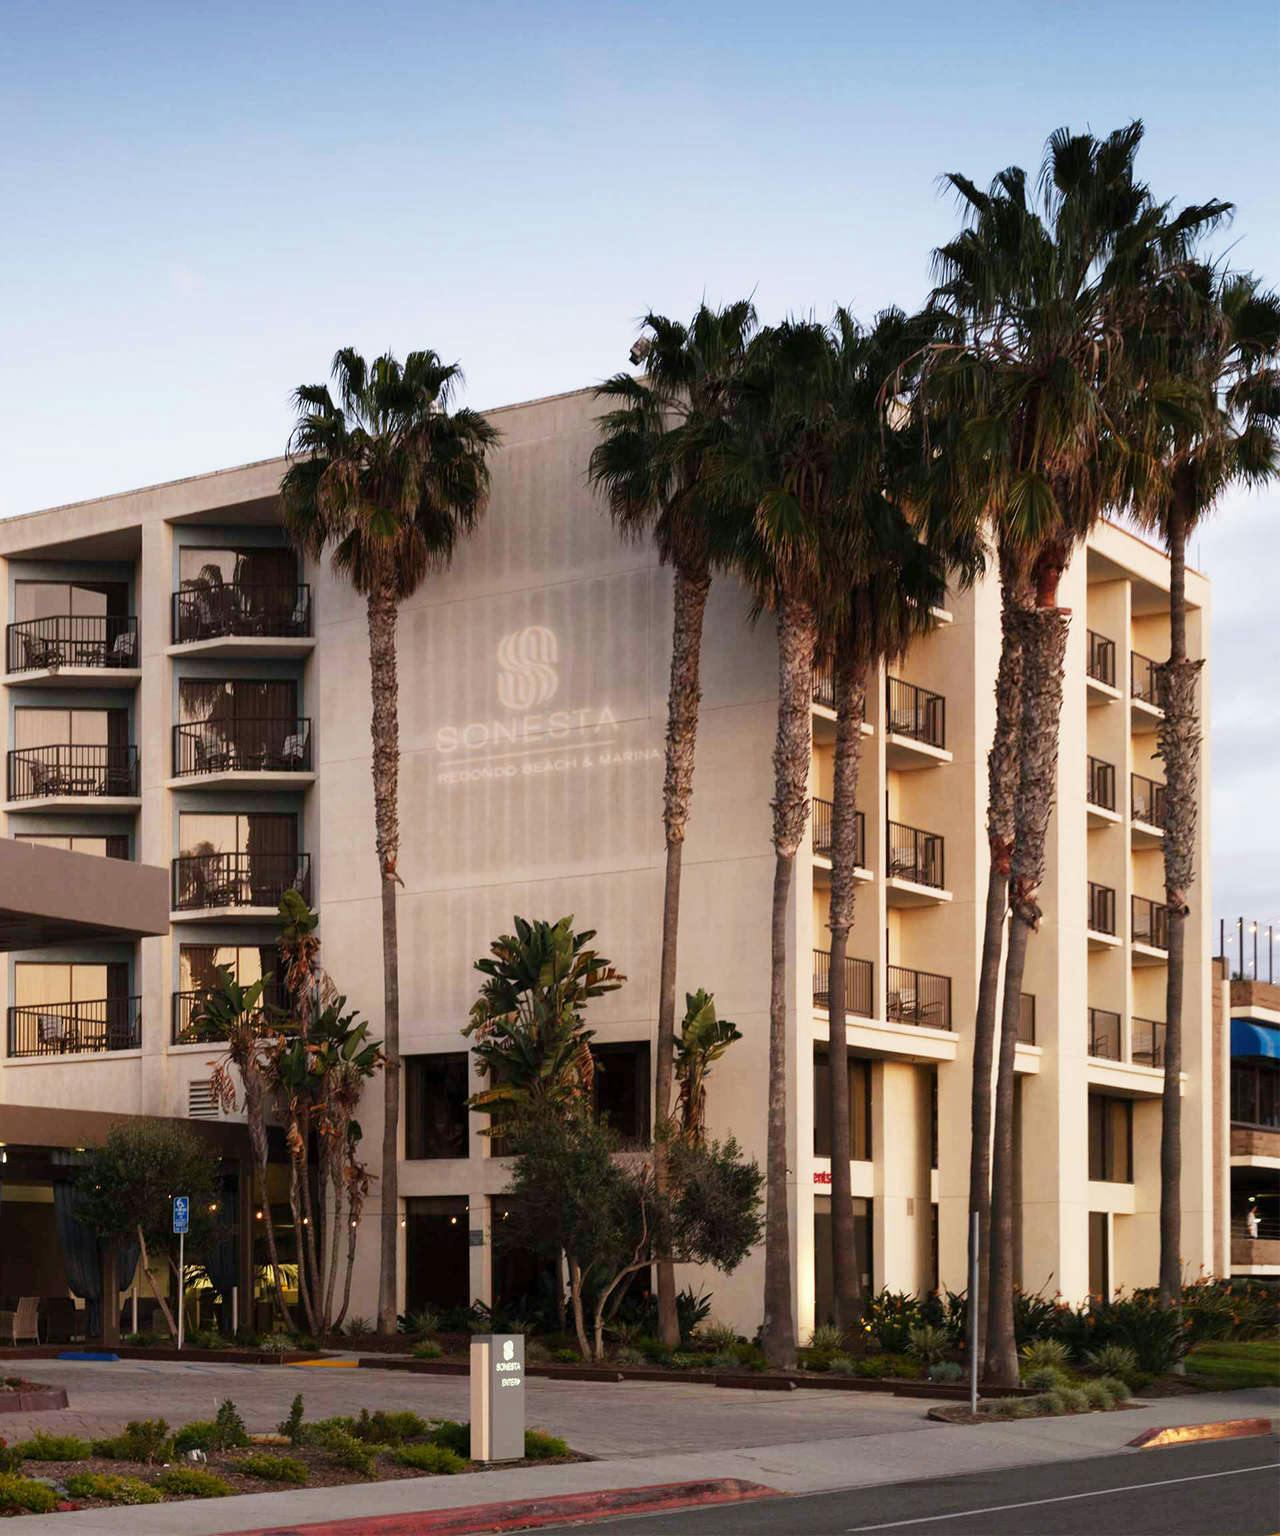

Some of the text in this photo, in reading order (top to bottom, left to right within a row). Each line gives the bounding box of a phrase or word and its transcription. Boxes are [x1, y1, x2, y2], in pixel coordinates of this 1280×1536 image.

[435, 705, 619, 753] SONESTA
[437, 748, 661, 784] REDONDO BEACH & MARINA
[495, 1362, 521, 1372] SONESTA
